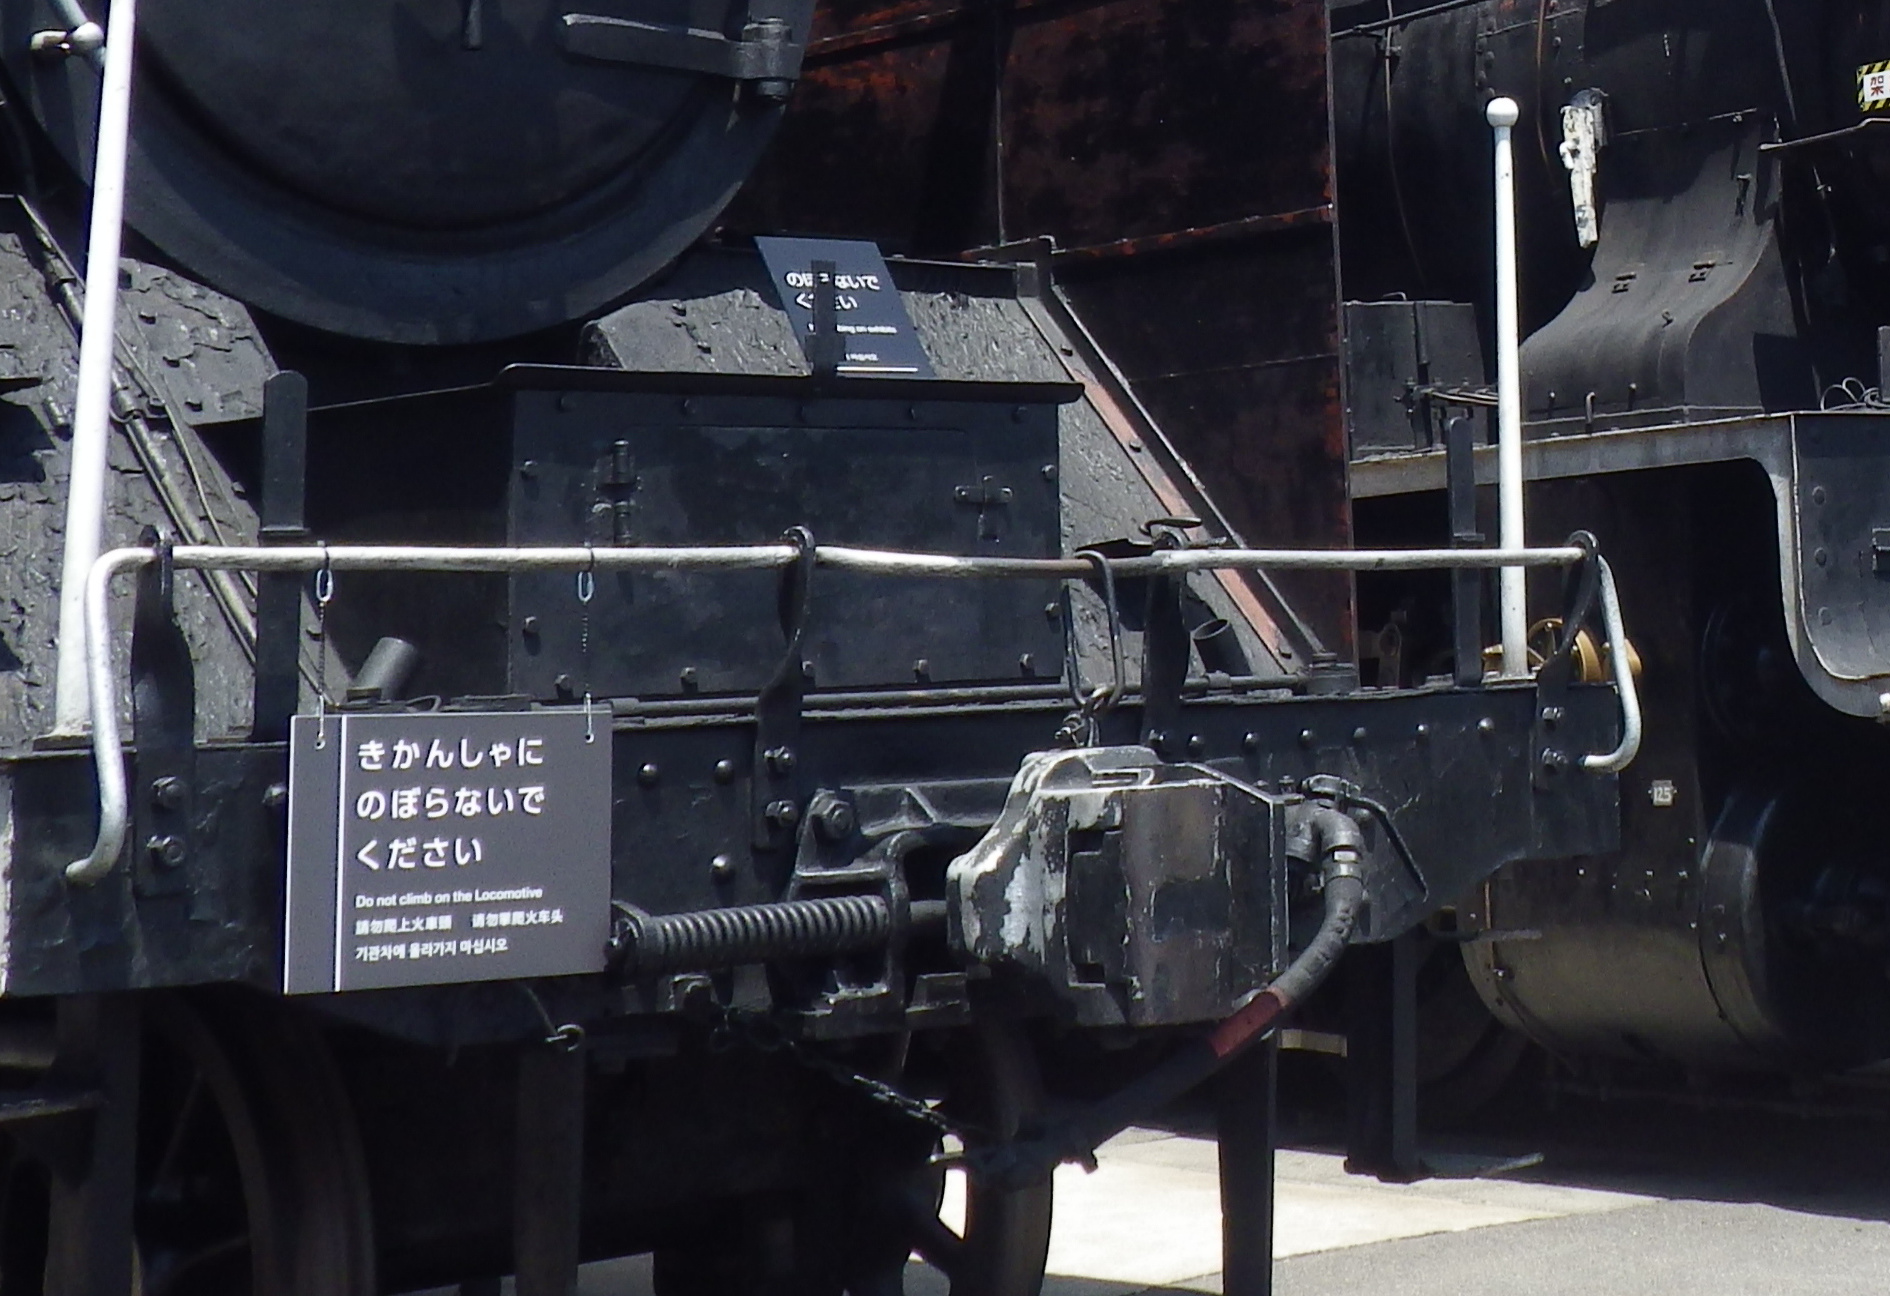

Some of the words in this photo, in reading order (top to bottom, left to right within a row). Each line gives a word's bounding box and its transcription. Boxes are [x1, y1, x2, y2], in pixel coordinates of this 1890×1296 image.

[358, 738, 543, 770] きかんしゃに
[356, 786, 545, 820] のぼらないで
[357, 837, 482, 870] ください
[355, 895, 374, 908] Do
[376, 894, 397, 906] not
[399, 891, 432, 905] climb
[434, 892, 450, 903] on
[453, 889, 472, 902] the
[474, 887, 543, 901] Locomotive
